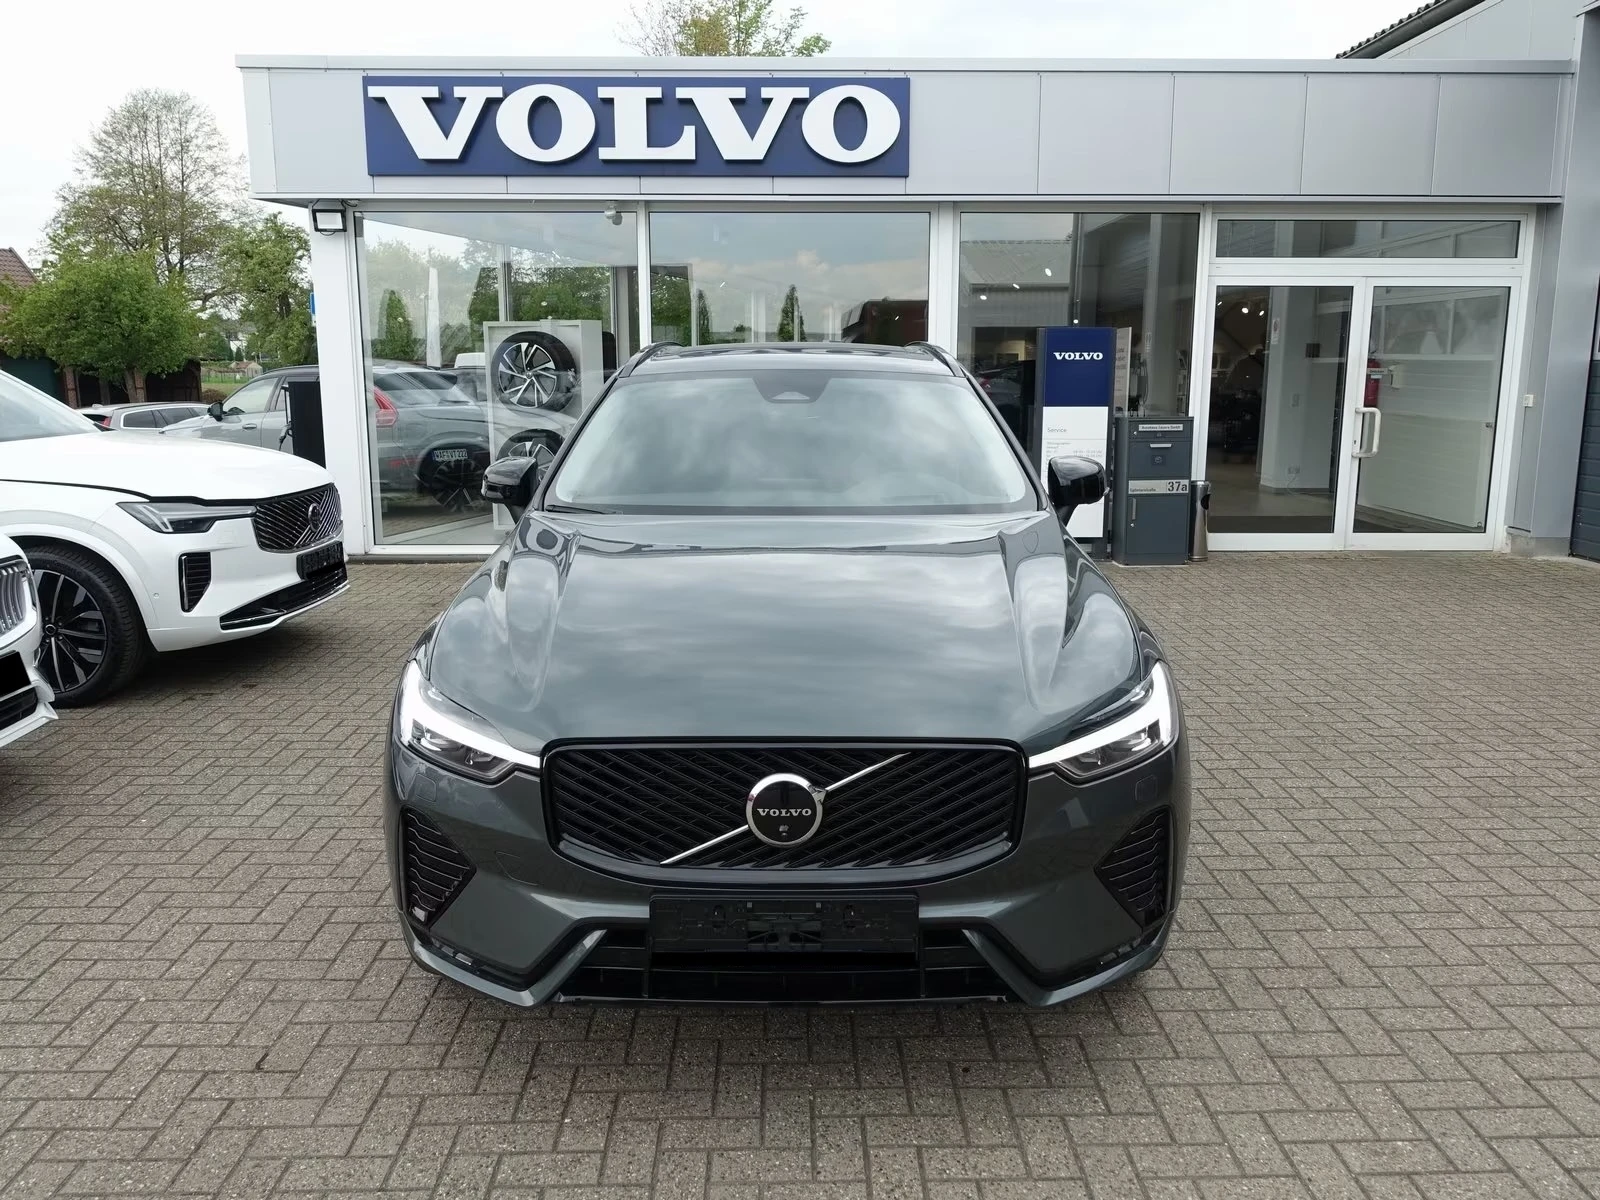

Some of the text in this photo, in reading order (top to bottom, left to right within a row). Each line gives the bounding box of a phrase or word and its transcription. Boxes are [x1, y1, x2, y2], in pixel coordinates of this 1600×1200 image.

[367, 83, 901, 163] VOLVO
[1053, 352, 1104, 361] VOLVO
[1167, 481, 1188, 492] 37a
[757, 808, 812, 817] VOLVO
